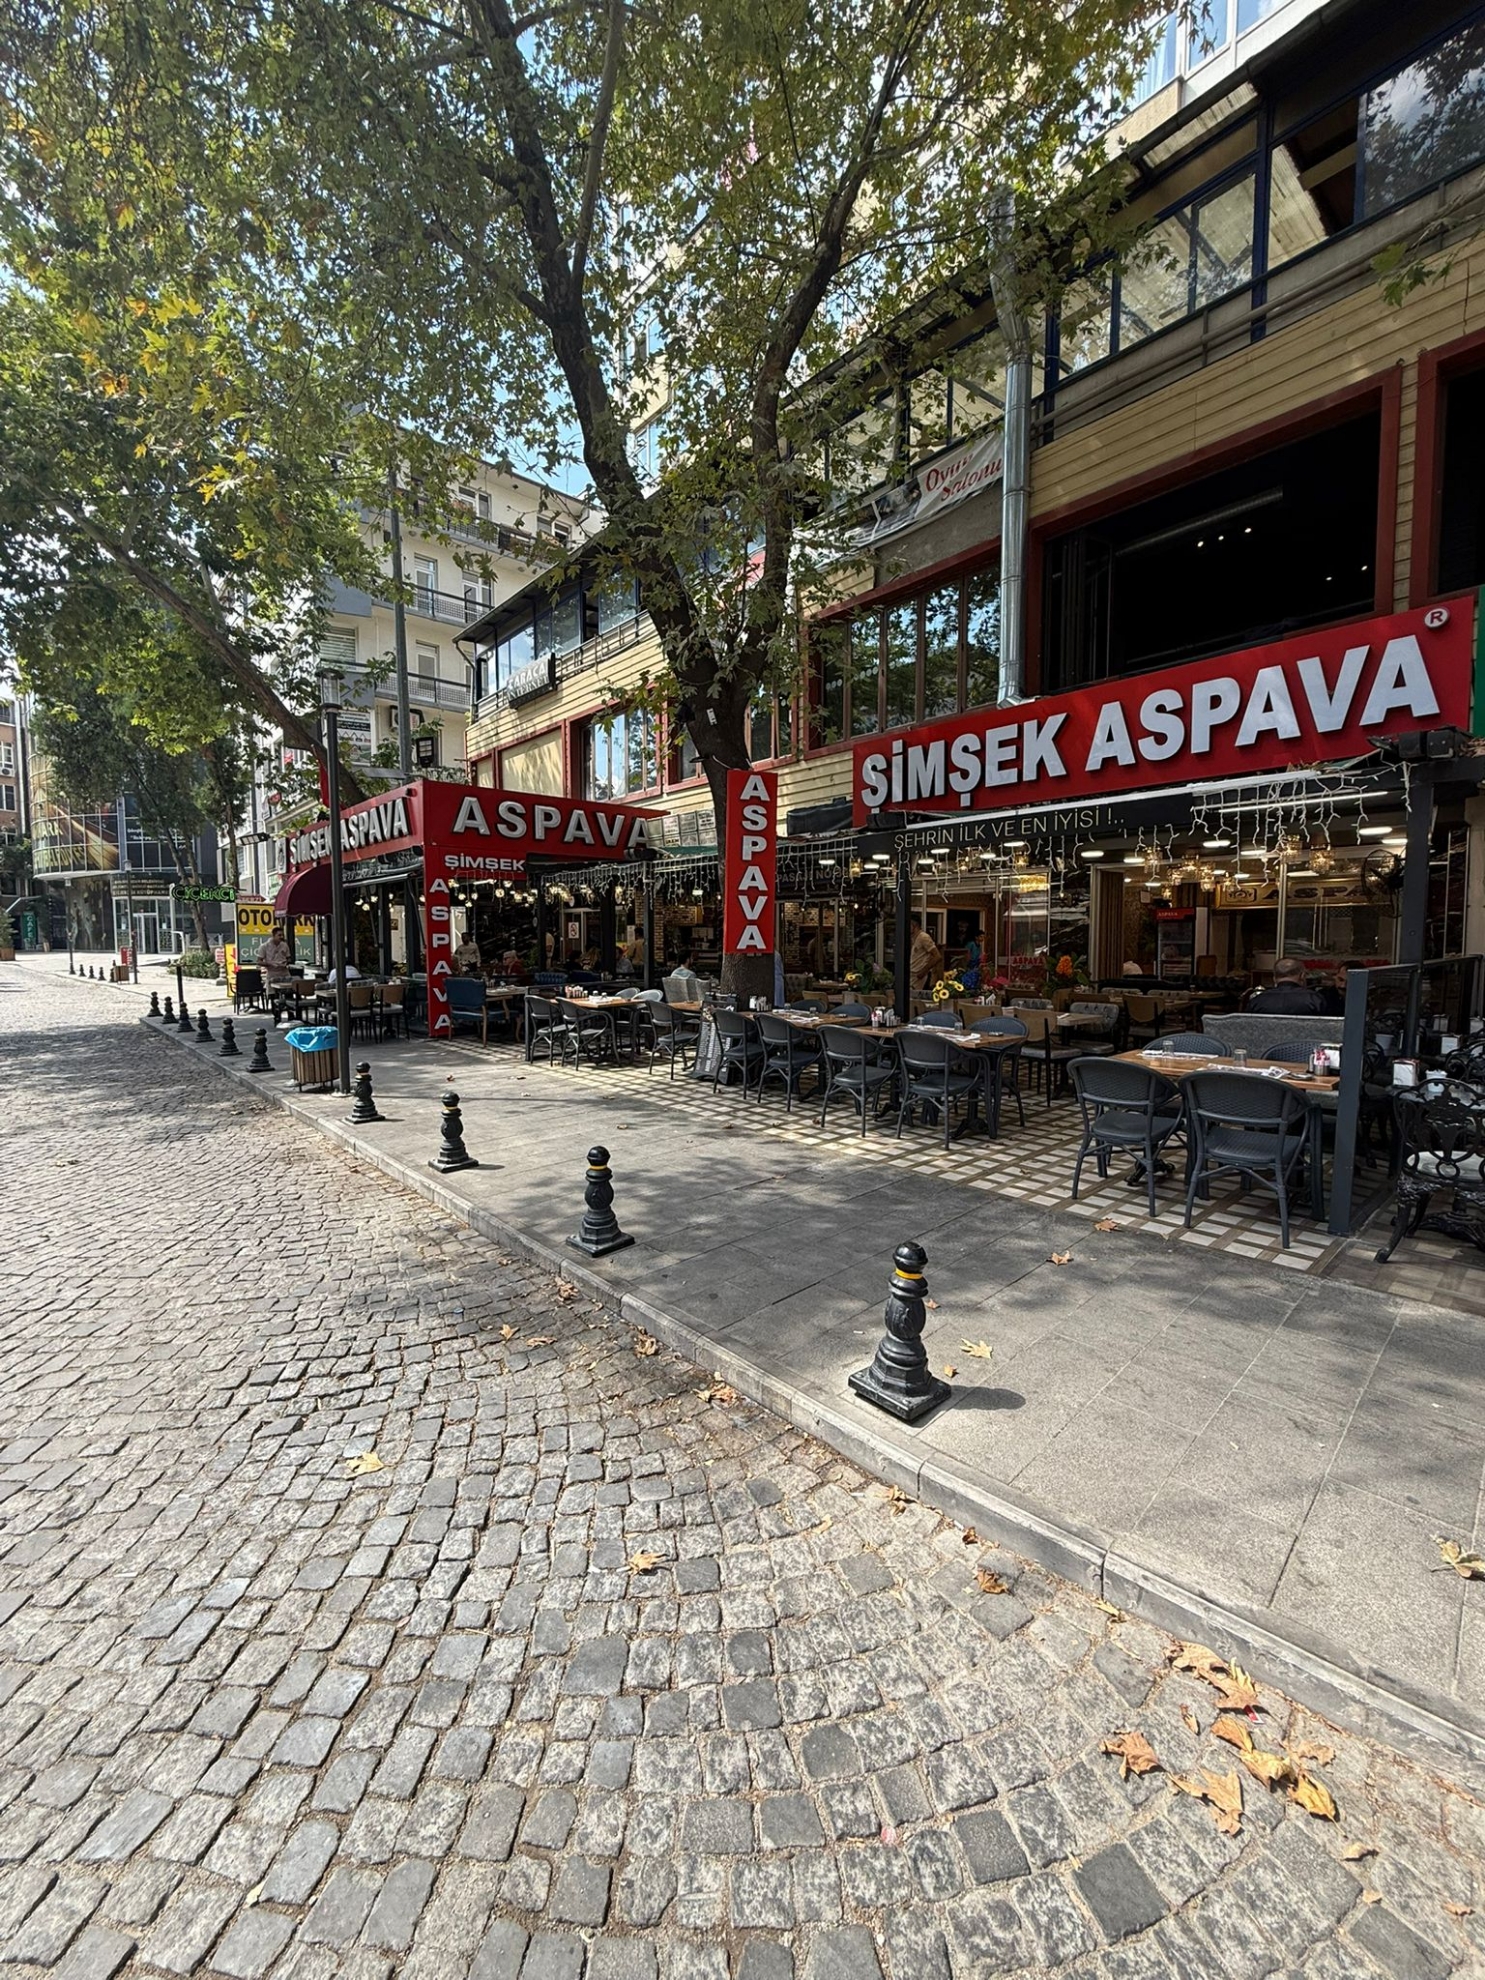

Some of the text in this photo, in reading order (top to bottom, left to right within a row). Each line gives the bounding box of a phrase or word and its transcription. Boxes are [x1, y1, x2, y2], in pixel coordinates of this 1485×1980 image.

[861, 634, 1441, 814] ŞİMŞEK ASPAVA
[444, 853, 526, 872] ŞİMŞEK
[452, 796, 650, 848] ASPAVA
[736, 774, 771, 950] ASPAVA
[893, 825, 954, 851] ŞEHRİN
[959, 822, 986, 842] İLK
[991, 819, 1016, 838] VE
[1021, 816, 1047, 835] EN
[1053, 806, 1100, 832] İYİSİ
[429, 878, 452, 1030] ASPAVA
